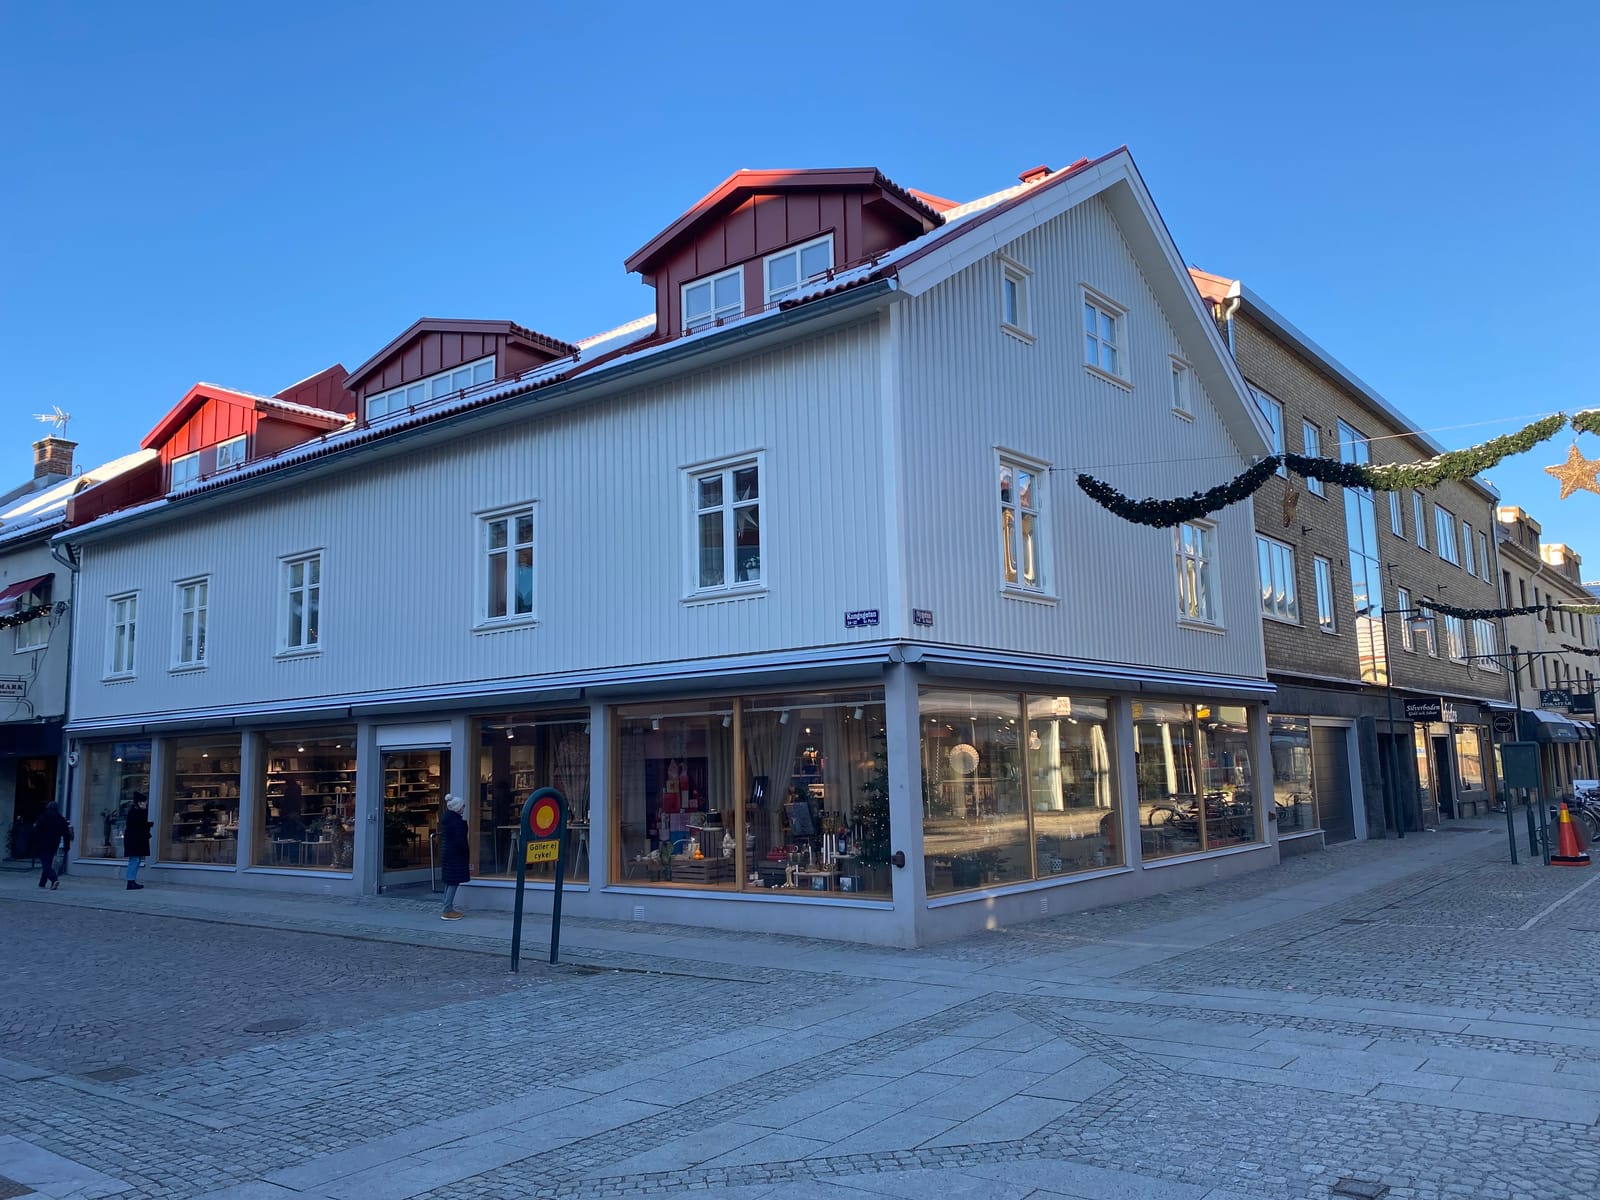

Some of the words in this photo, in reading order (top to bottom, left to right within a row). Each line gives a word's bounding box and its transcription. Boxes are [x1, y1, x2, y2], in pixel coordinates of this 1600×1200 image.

[529, 843, 549, 851] Gäller
[551, 842, 557, 850] ej
[534, 851, 552, 859] cykel
